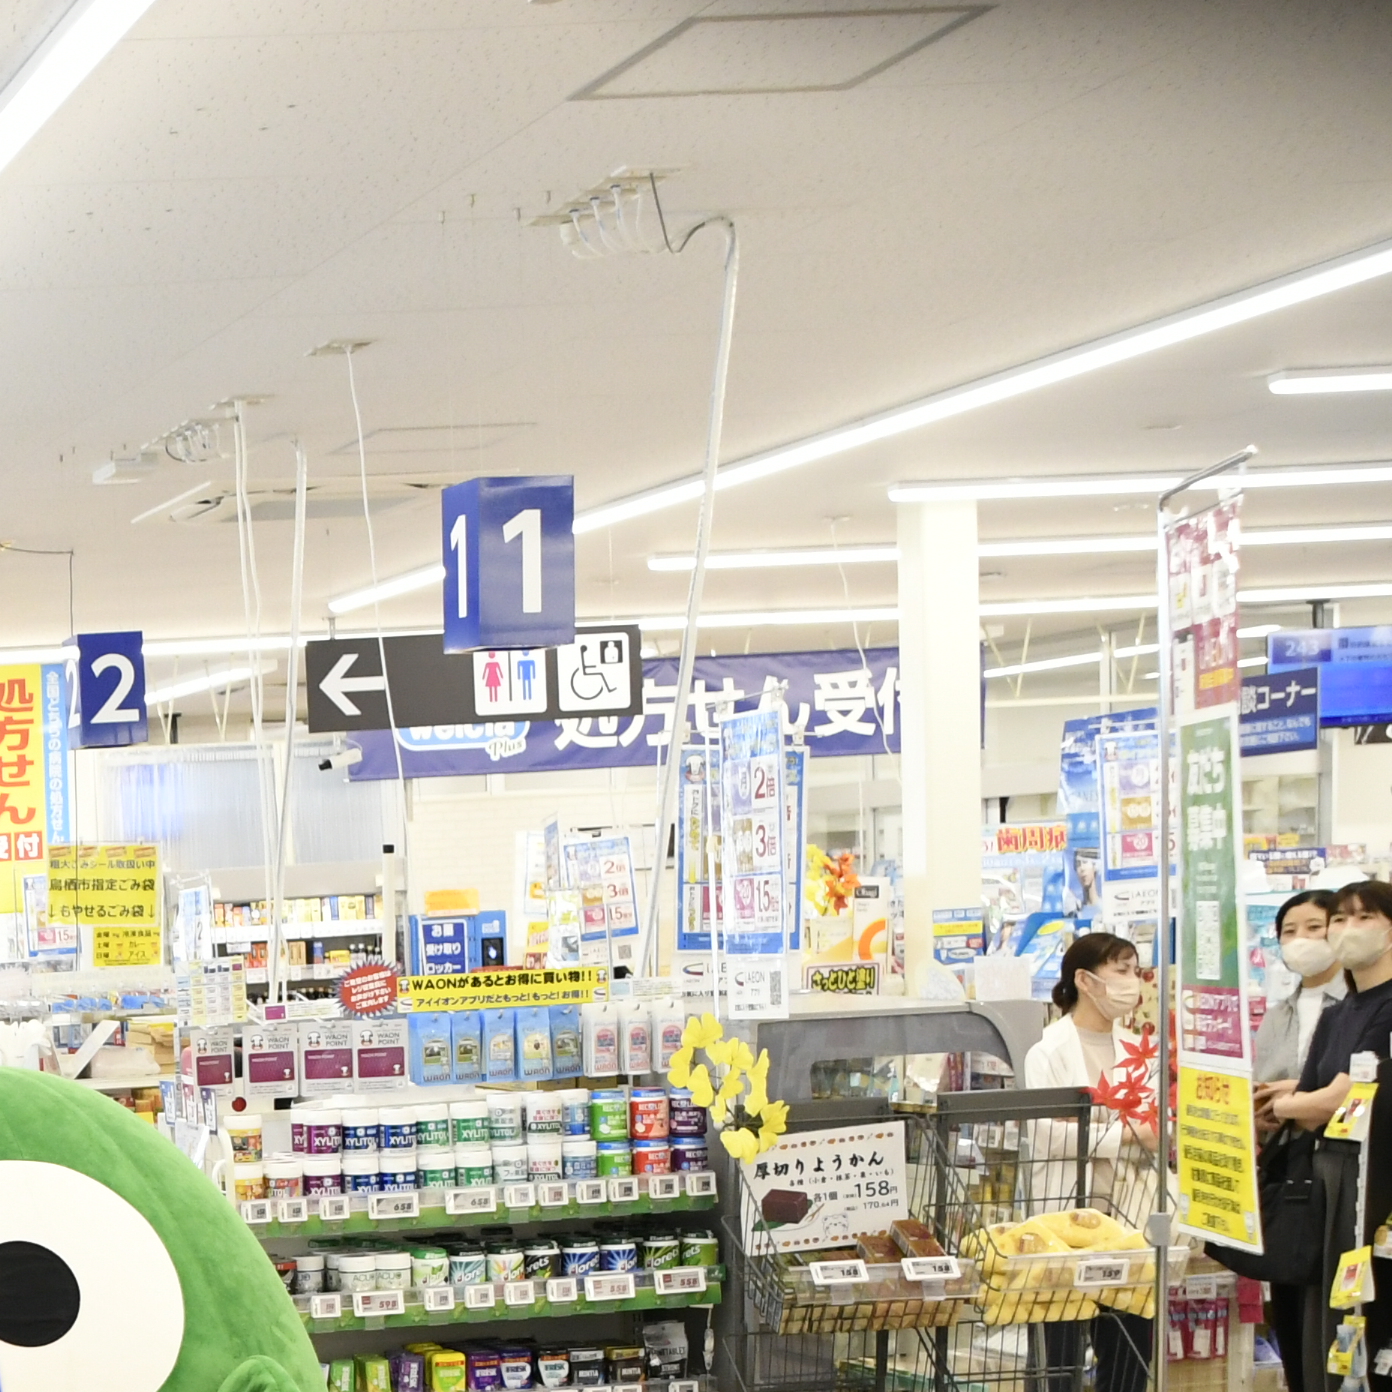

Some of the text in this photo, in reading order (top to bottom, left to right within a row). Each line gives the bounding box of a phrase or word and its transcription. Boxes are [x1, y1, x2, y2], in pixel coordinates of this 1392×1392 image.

[450, 514, 469, 619] 1
[504, 508, 542, 613] 1
[91, 653, 140, 724] 2
[49, 879, 155, 892] 鳥栖市指定ごみ袋
[60, 905, 144, 918] もやせるごみ袋
[812, 968, 876, 992] さっとひと塗り
[753, 1151, 884, 1181] 厚切りようかん
[813, 1180, 898, 1203] 各1個 158円
